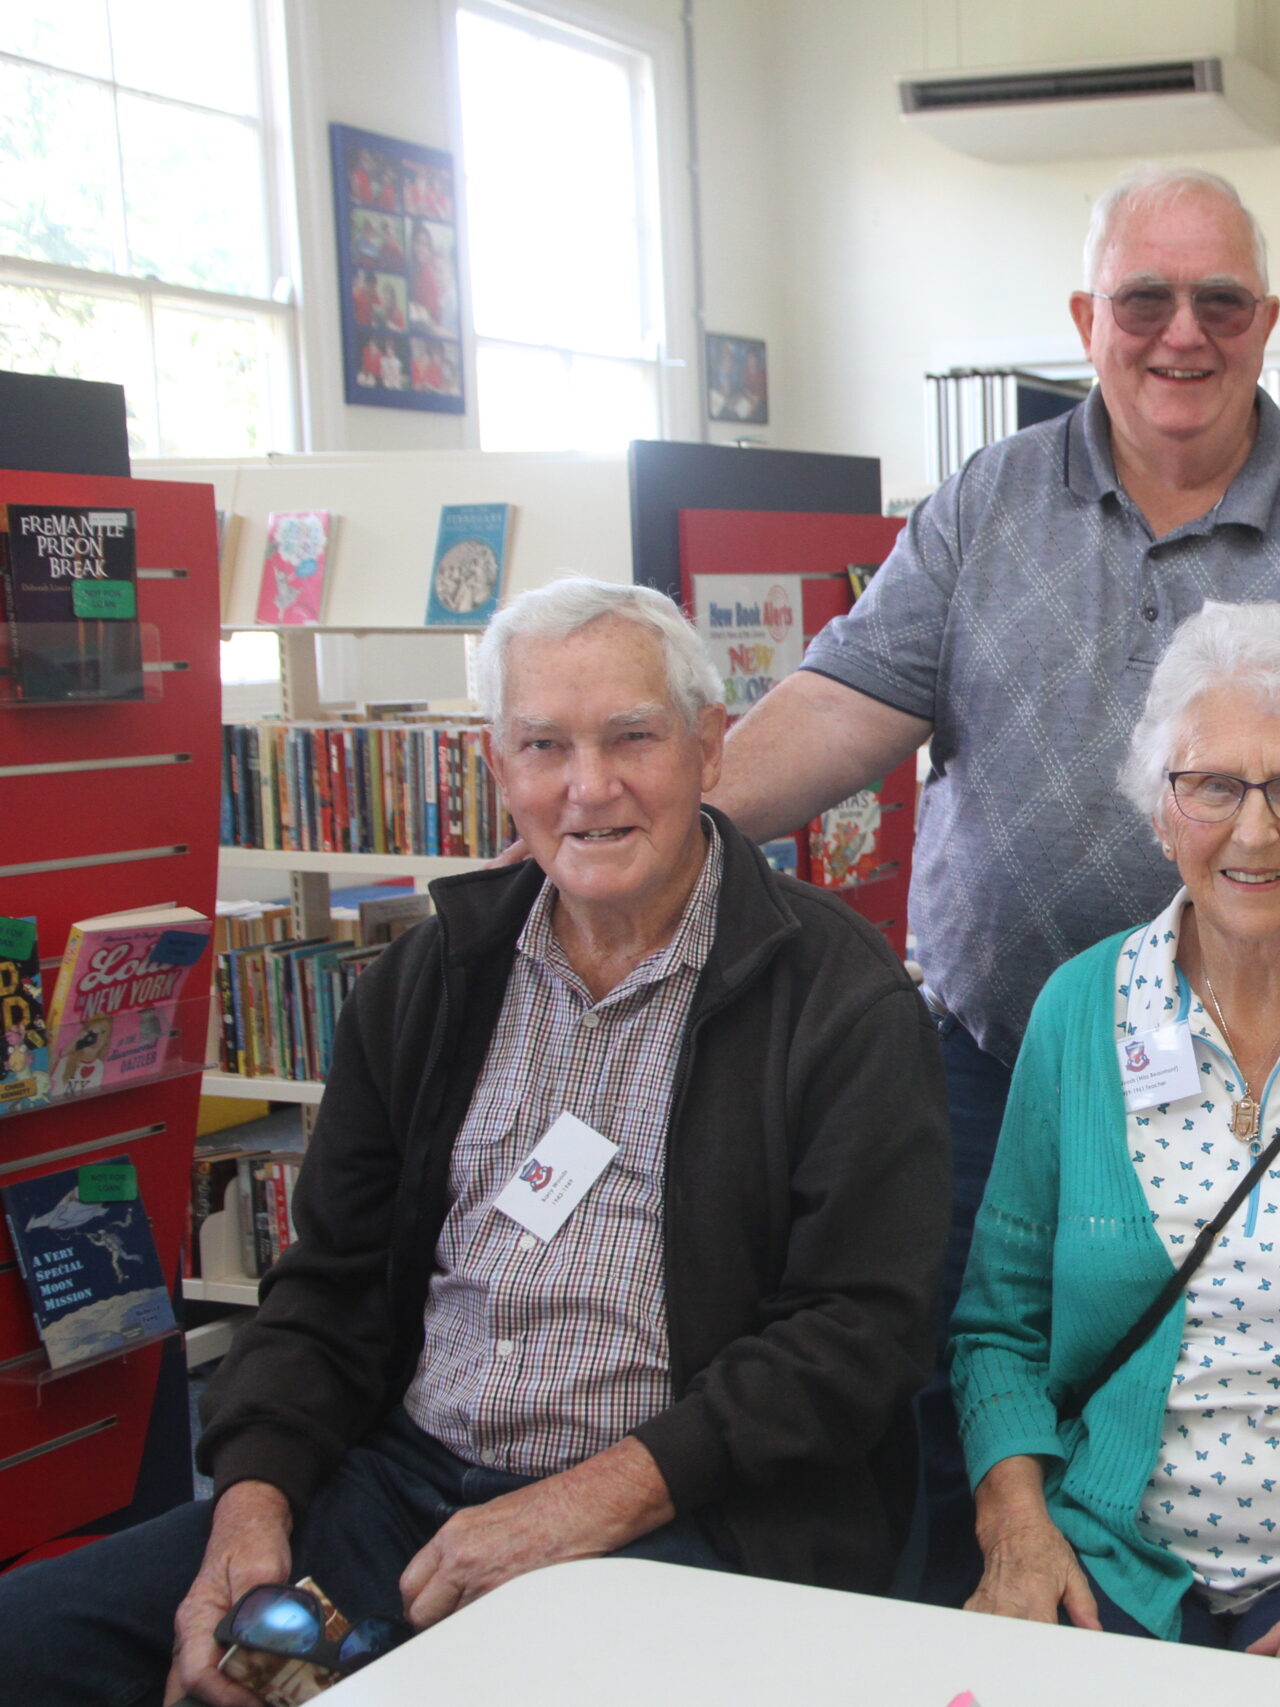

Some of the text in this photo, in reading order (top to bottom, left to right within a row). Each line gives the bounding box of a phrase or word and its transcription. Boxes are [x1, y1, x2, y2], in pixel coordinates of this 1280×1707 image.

[20, 514, 125, 538] FREMANTLE
[37, 535, 104, 558] PRISON
[50, 557, 109, 579] BREAK
[728, 643, 776, 675] NEW
[83, 972, 177, 1020] NEW YORK
[33, 1247, 75, 1267] A VERY
[35, 1260, 84, 1282] SPECIAL
[40, 1278, 74, 1296] MOON
[44, 1288, 93, 1311] MISSION
